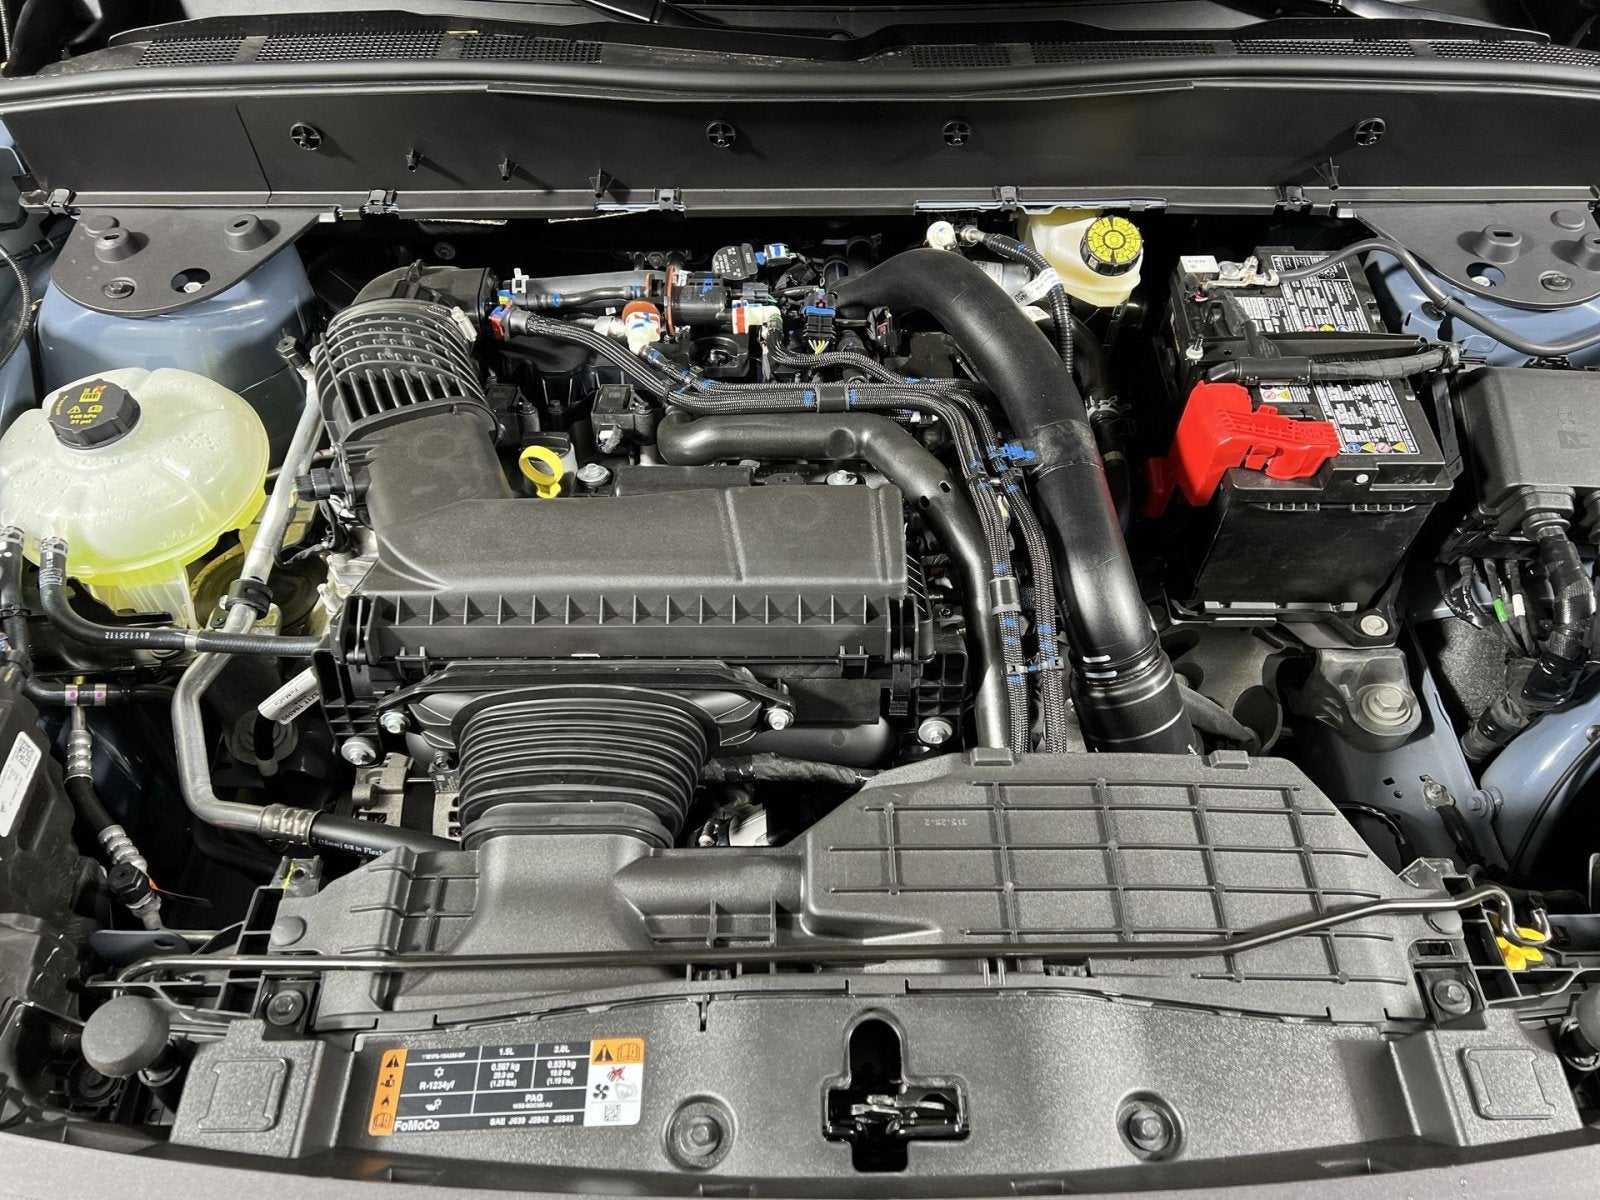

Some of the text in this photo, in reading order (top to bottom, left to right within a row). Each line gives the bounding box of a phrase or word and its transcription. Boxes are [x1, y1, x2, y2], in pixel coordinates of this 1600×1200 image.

[510, 1062, 521, 1073] kg
[567, 1059, 577, 1070] kg
[419, 1080, 456, 1091] R-1234yf
[525, 1093, 544, 1103] PAG
[394, 1119, 440, 1132] FoMoCo
[489, 1117, 506, 1126] SAE
